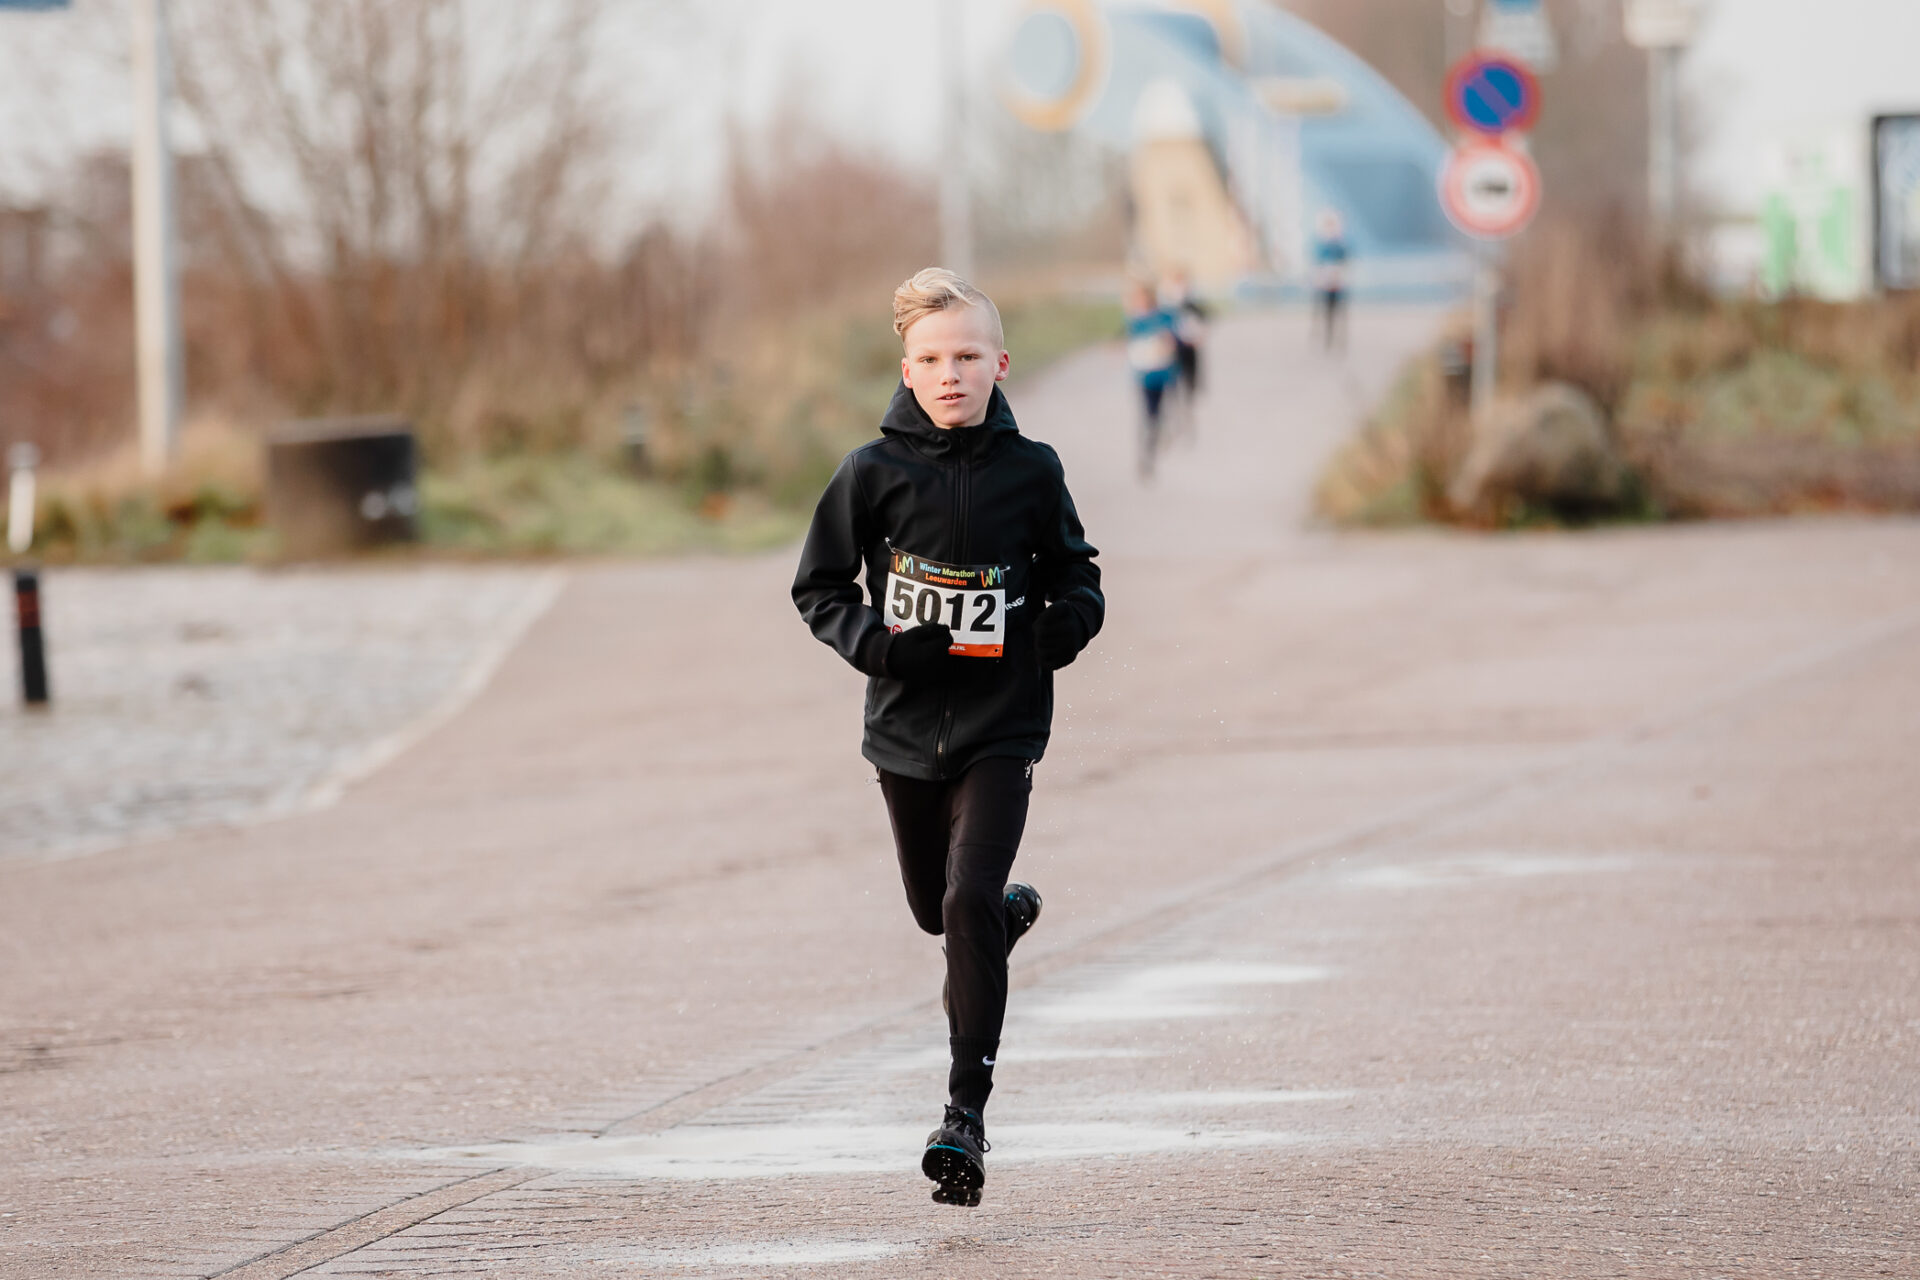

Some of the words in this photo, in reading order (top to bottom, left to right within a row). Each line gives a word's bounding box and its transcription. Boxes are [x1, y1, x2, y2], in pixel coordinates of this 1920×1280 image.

[919, 562, 941, 575] Winter
[942, 567, 976, 578] Marathon
[925, 573, 967, 586] Leeuwarden
[892, 579, 997, 632] 5012
